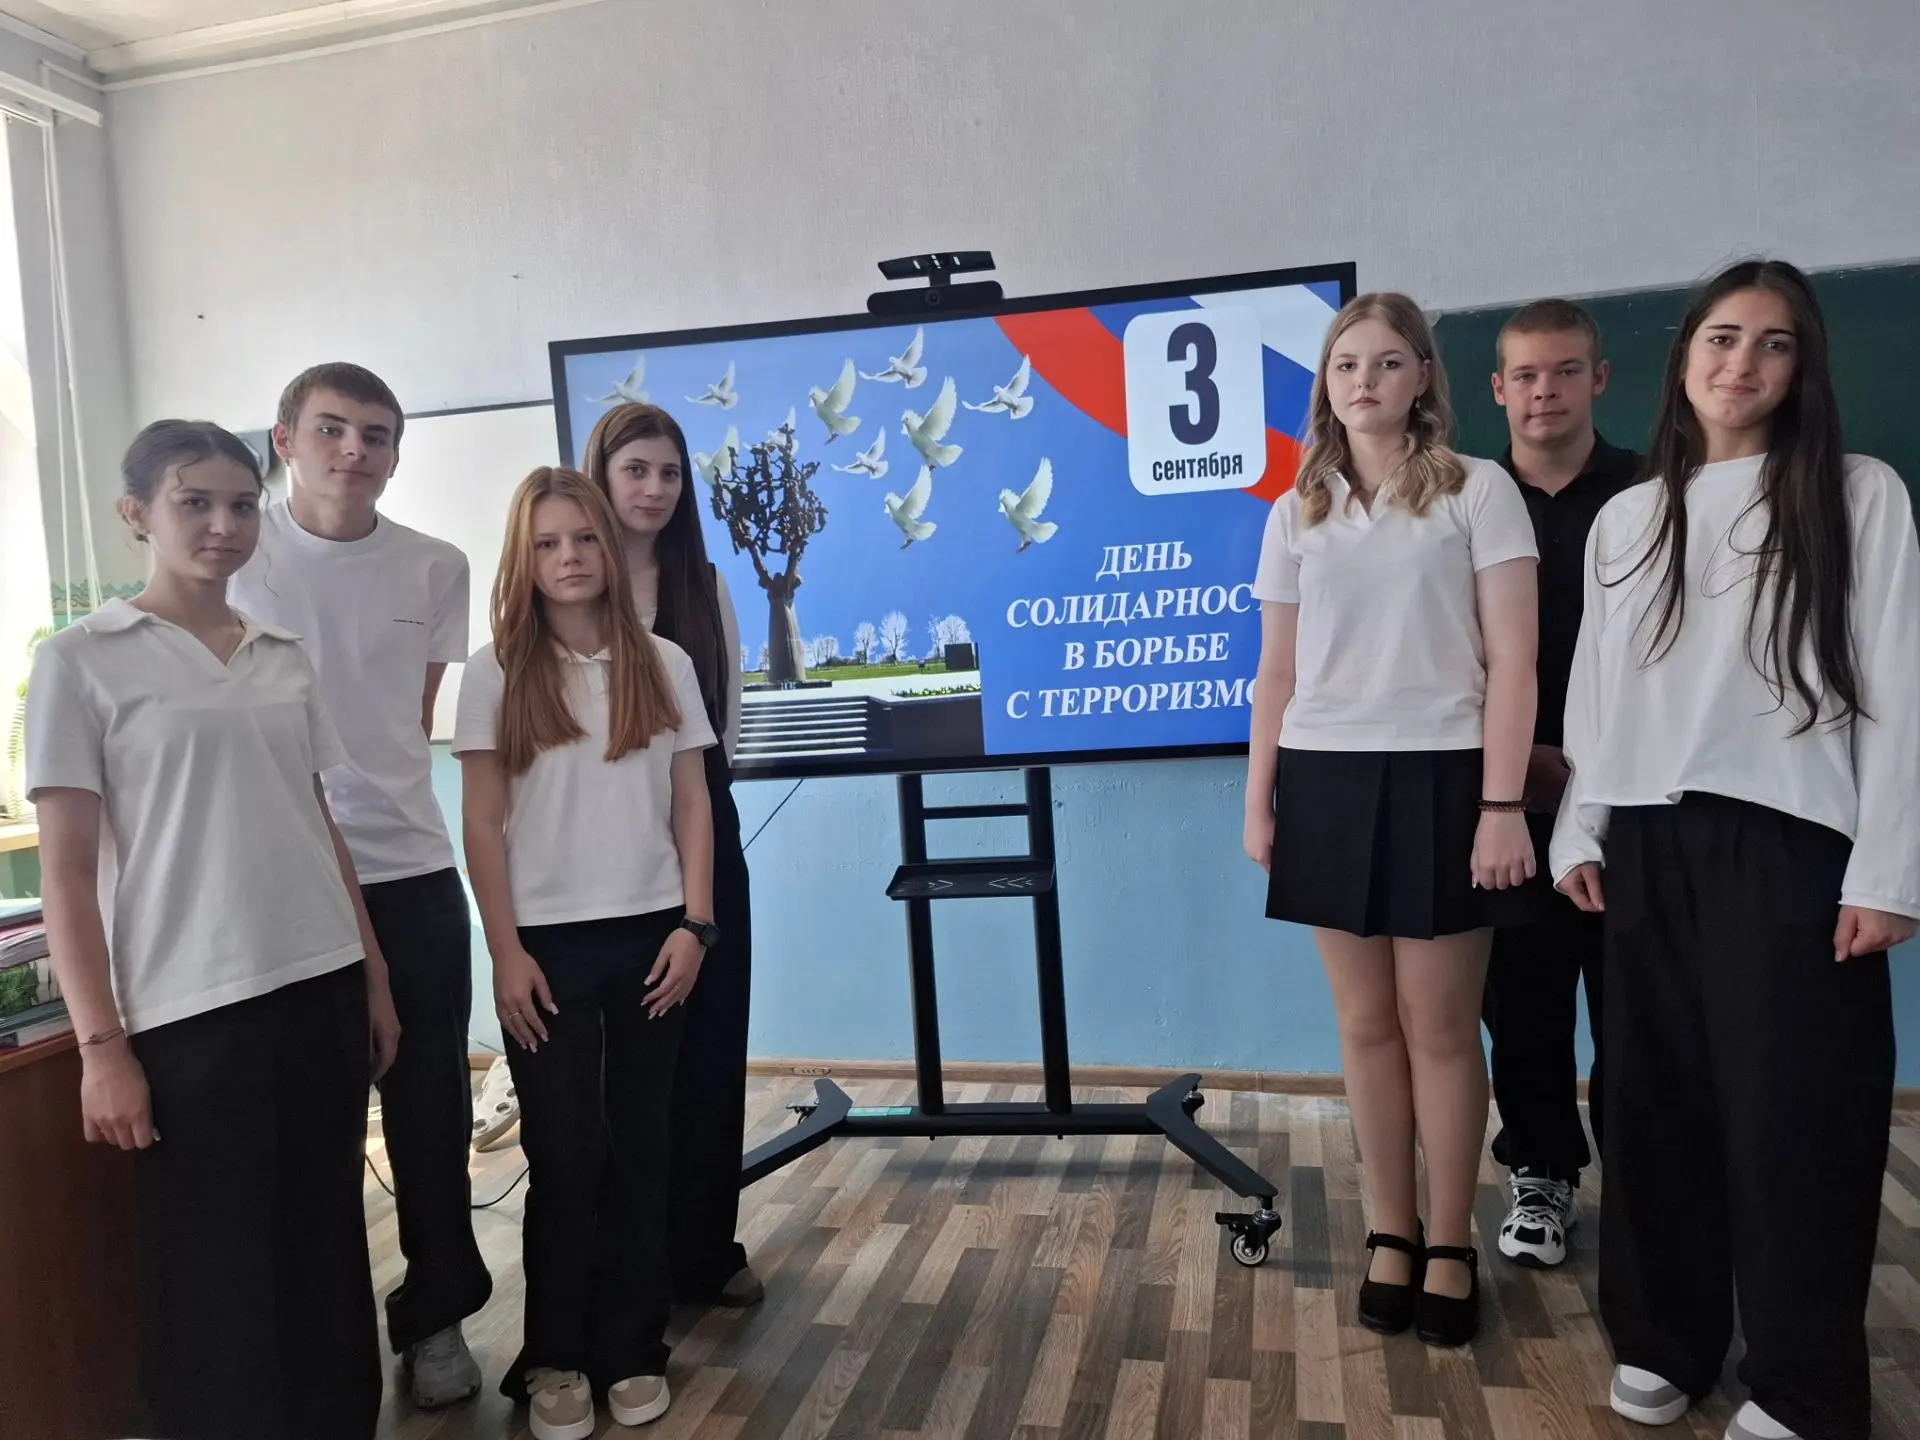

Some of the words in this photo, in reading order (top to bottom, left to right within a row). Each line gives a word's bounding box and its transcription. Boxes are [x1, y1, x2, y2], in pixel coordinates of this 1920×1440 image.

[1167, 322, 1220, 445] 3
[1152, 452, 1243, 481] сентября
[1095, 541, 1193, 582] ДЕНЬ
[1006, 583, 1262, 628] СОЛИДАРНОС
[1062, 642, 1085, 670] В
[1093, 632, 1230, 669] БОРЬБЕ
[1006, 691, 1030, 719] С
